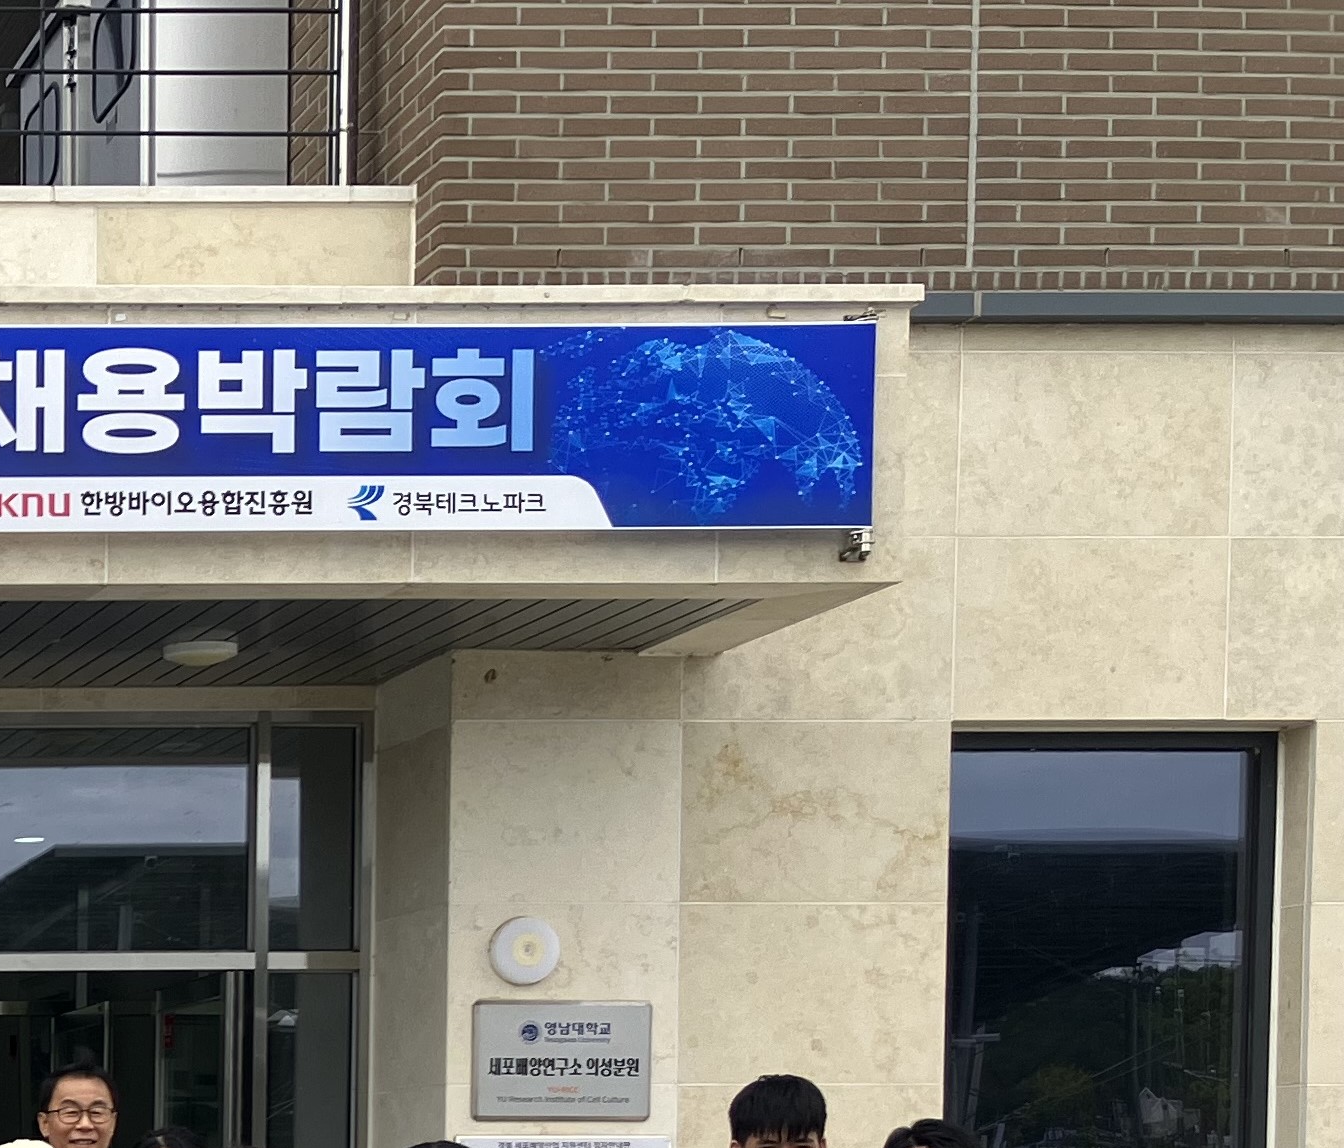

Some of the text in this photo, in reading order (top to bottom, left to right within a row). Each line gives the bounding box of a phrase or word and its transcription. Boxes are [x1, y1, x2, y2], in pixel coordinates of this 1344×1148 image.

[80, 489, 313, 517] 한방바이오융합진흥원
[392, 491, 547, 517] 경북테크노파크
[544, 1021, 611, 1036] 영남대학교
[487, 1057, 640, 1077] 세포배양연구소 의성분원
